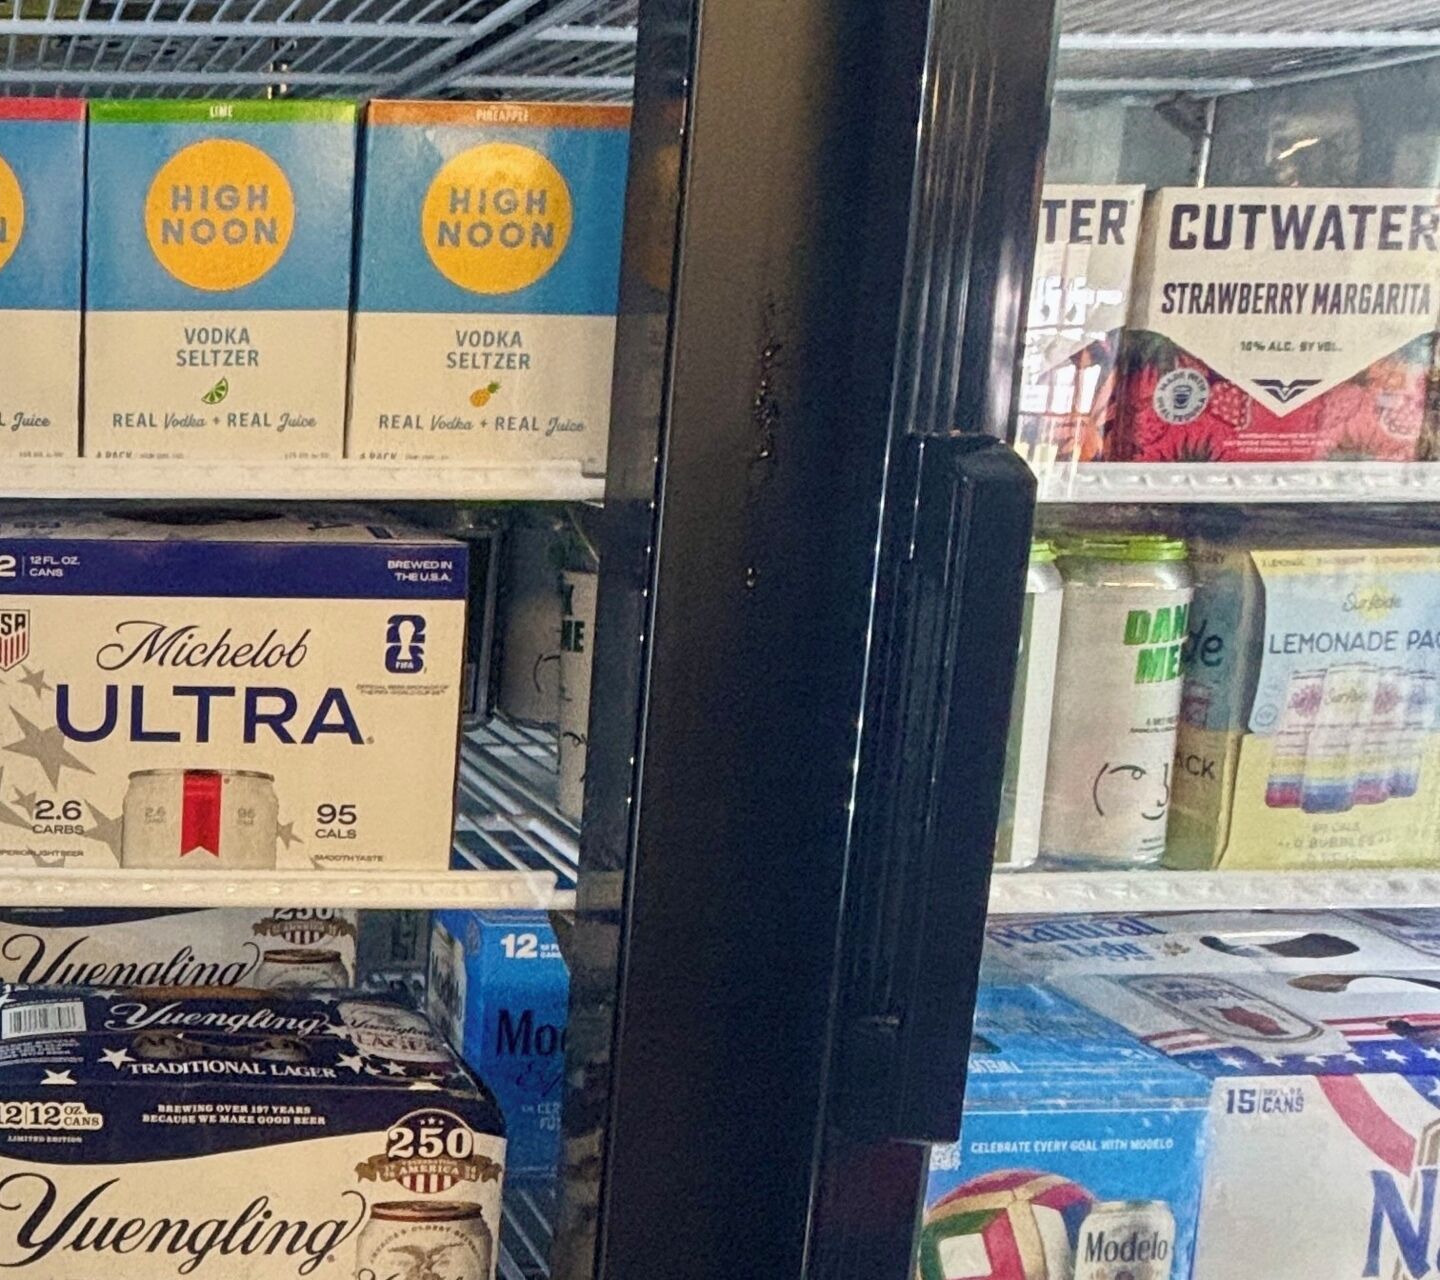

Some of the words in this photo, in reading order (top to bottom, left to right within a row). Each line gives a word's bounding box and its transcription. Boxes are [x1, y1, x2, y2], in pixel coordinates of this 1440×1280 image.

[209, 104, 233, 118] LIME
[171, 184, 269, 212] HIGH
[448, 187, 549, 215] HIGH
[161, 218, 278, 246] NOON
[437, 221, 555, 249] NOON
[1168, 203, 1440, 251] CUTWATER
[1161, 282, 1307, 315] STRAWBERRY
[1312, 282, 1431, 315] MARGARITA
[184, 328, 250, 345] VODKA
[455, 330, 522, 348] VODKA
[176, 349, 260, 367] SELTZER
[446, 351, 531, 370] SELTZER
[11, 410, 51, 432] Juice
[379, 414, 424, 430] REAL
[429, 414, 473, 431] Vodka
[494, 415, 539, 432] REAL
[545, 416, 585, 437] Juice
[29, 568, 63, 577] CANS
[387, 561, 440, 569] BREWED
[441, 561, 452, 569] IN
[395, 573, 419, 581] THE
[96, 620, 311, 671] Michelob
[395, 661, 413, 669] FIFA
[57, 684, 366, 746] ULTRA
[34, 800, 82, 820] 2.6
[316, 804, 358, 824] 95
[32, 824, 84, 835] CARBS
[315, 829, 357, 839] CALS
[313, 854, 353, 862] SMOOTH
[354, 854, 385, 862] TASTE
[500, 933, 538, 959] 12
[105, 1003, 330, 1036] Yuengling
[128, 1062, 265, 1077] TRADITIONAL
[270, 1064, 337, 1078] LAGER
[158, 1104, 212, 1114] BREWING
[215, 1105, 247, 1114] OVER
[271, 1106, 311, 1115] YEARS
[1226, 1089, 1255, 1114] 15
[1263, 1096, 1304, 1113] CANS
[30, 1106, 62, 1128] 12
[63, 1115, 100, 1127] CANS
[142, 1114, 197, 1124] BECAUSE
[198, 1115, 218, 1124] WE
[219, 1115, 255, 1124] MAKE
[257, 1116, 291, 1125] GOOD
[293, 1116, 326, 1125] BEER
[388, 1127, 473, 1159] 250
[970, 1141, 1031, 1154] CELEBRATE
[1033, 1140, 1067, 1152] EVERY
[1070, 1140, 1098, 1152] GOAL
[1101, 1139, 1128, 1151] WITH
[1130, 1138, 1174, 1150] MODELO
[1085, 1230, 1168, 1264] Modelo
